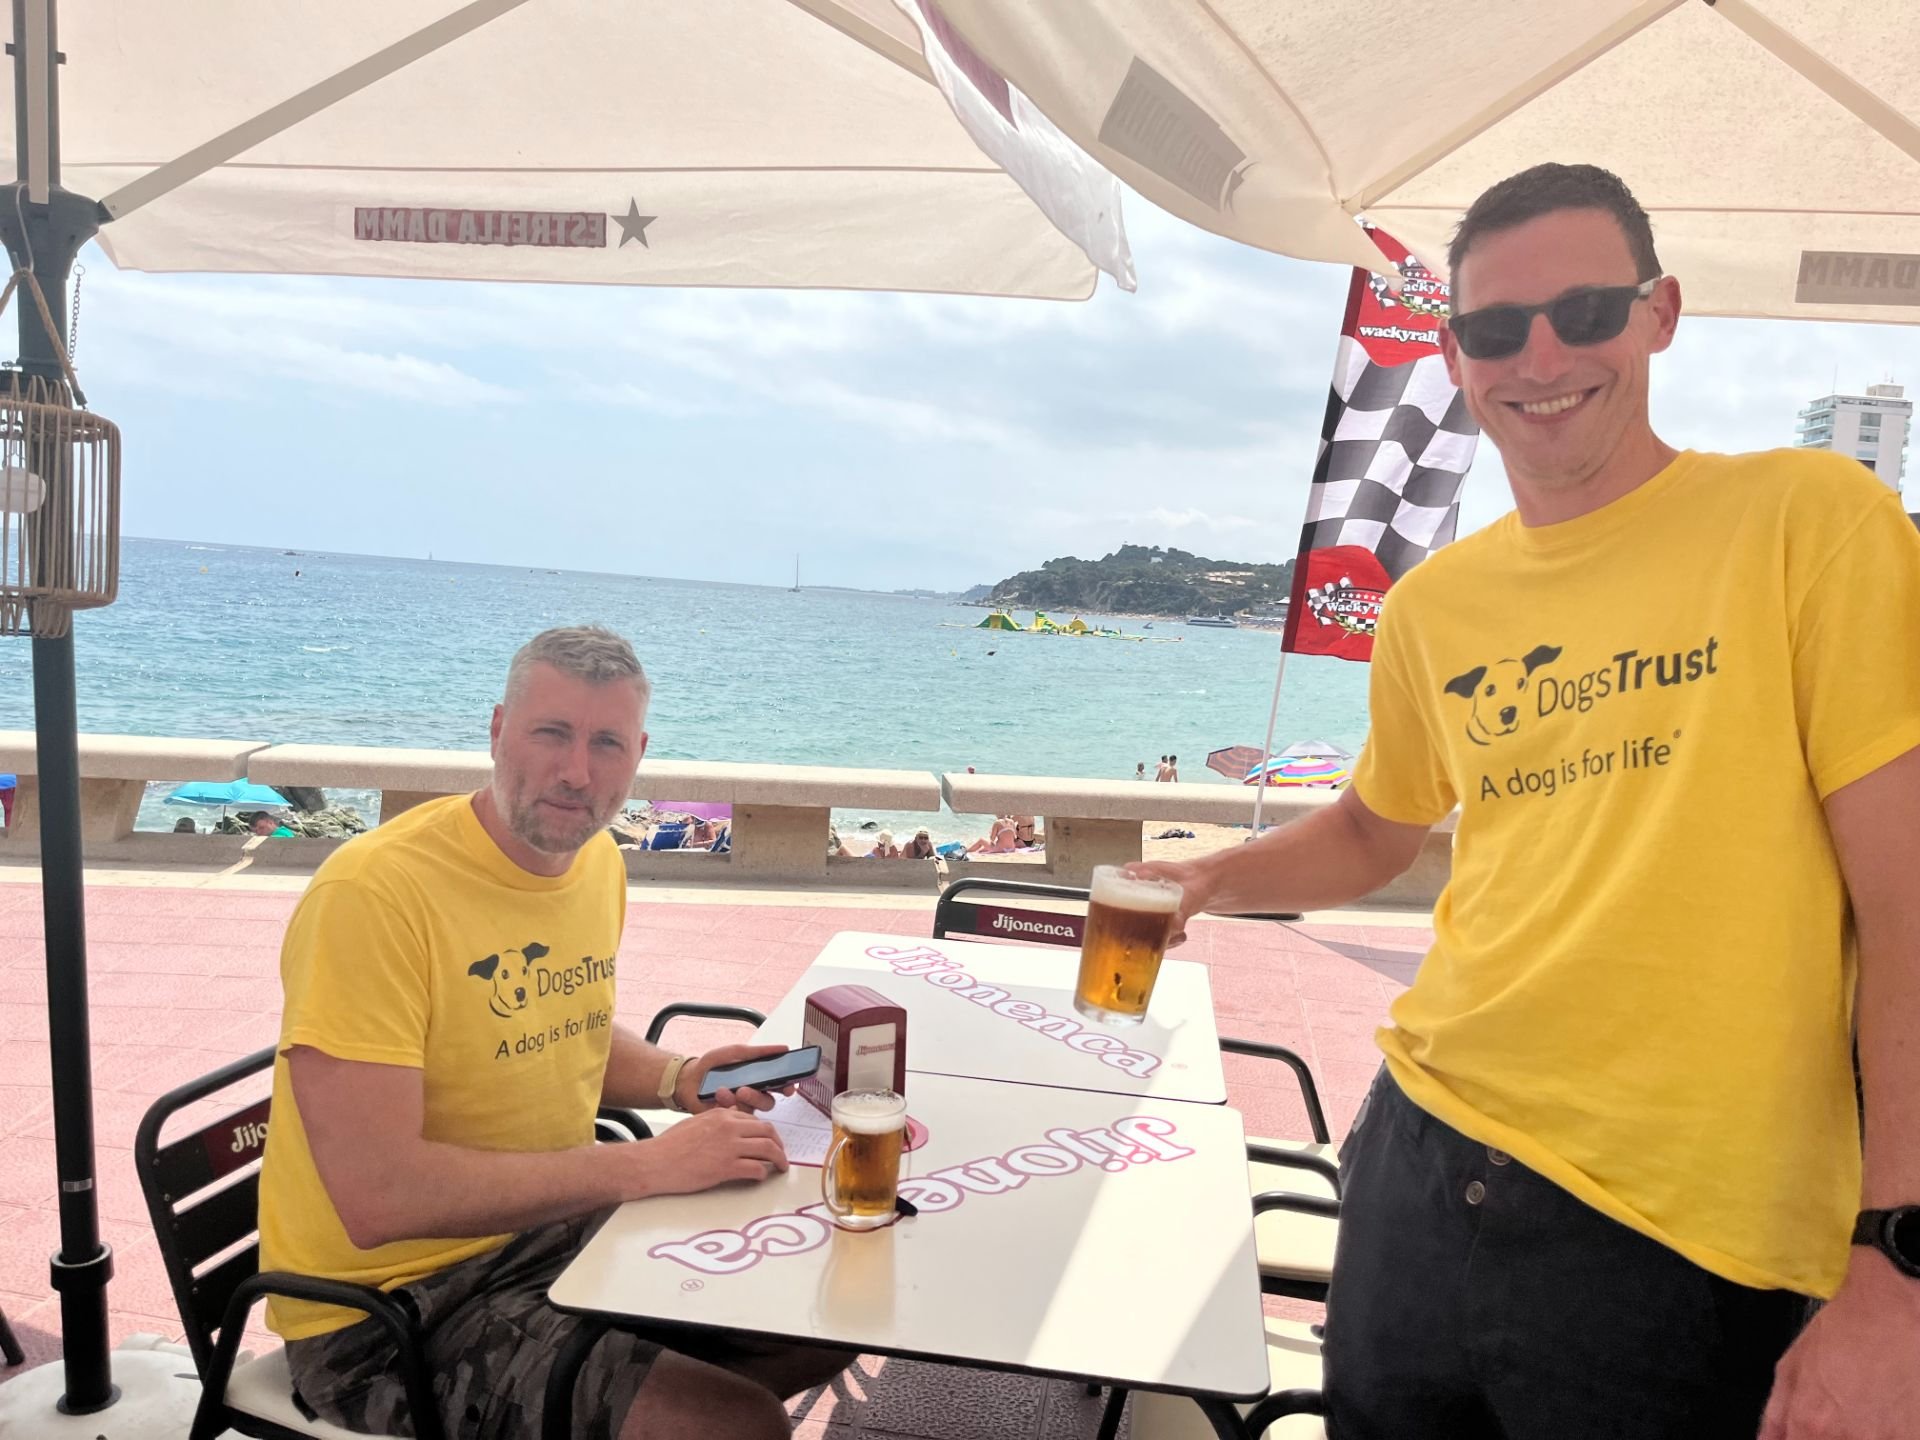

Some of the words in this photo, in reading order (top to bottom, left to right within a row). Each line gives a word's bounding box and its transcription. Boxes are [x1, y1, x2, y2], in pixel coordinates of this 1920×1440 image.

[1403, 280, 1438, 295] acky
[1326, 600, 1371, 616] Wacky
[1480, 775, 1501, 801] A
[1507, 767, 1555, 797] dog
[1561, 758, 1577, 785] is
[1582, 749, 1615, 779] for
[992, 913, 1077, 938] Jijonenca
[536, 952, 616, 997] DogsTrus
[865, 945, 1163, 1079] Jijonenca
[494, 1040, 510, 1060] A
[515, 1033, 545, 1053] dog
[549, 1026, 560, 1044] is
[565, 1018, 584, 1039] for
[231, 1122, 270, 1153] Jijo
[646, 1115, 1197, 1275] Jijoneca
